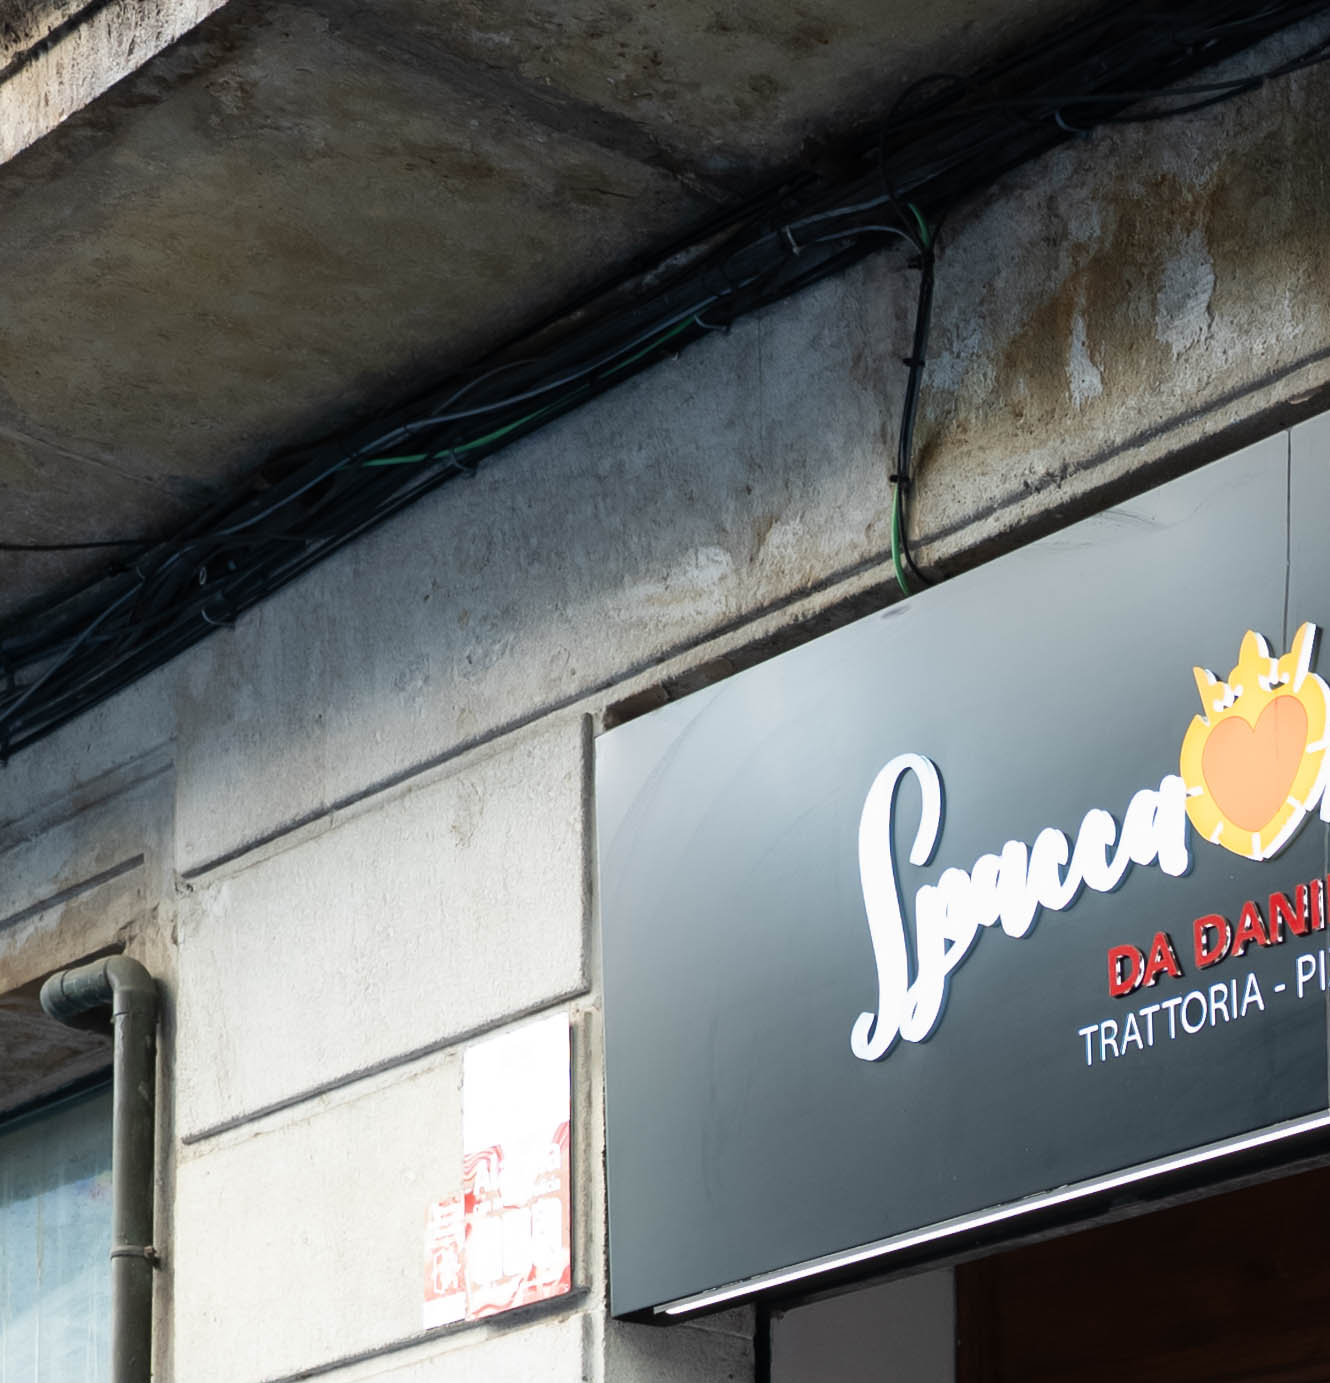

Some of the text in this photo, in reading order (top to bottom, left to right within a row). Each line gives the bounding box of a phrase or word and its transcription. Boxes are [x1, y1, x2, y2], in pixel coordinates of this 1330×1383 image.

[850, 752, 1192, 1063] Spacca
[1107, 931, 1183, 999] DA
[1077, 972, 1266, 1067] TRATTORIA
